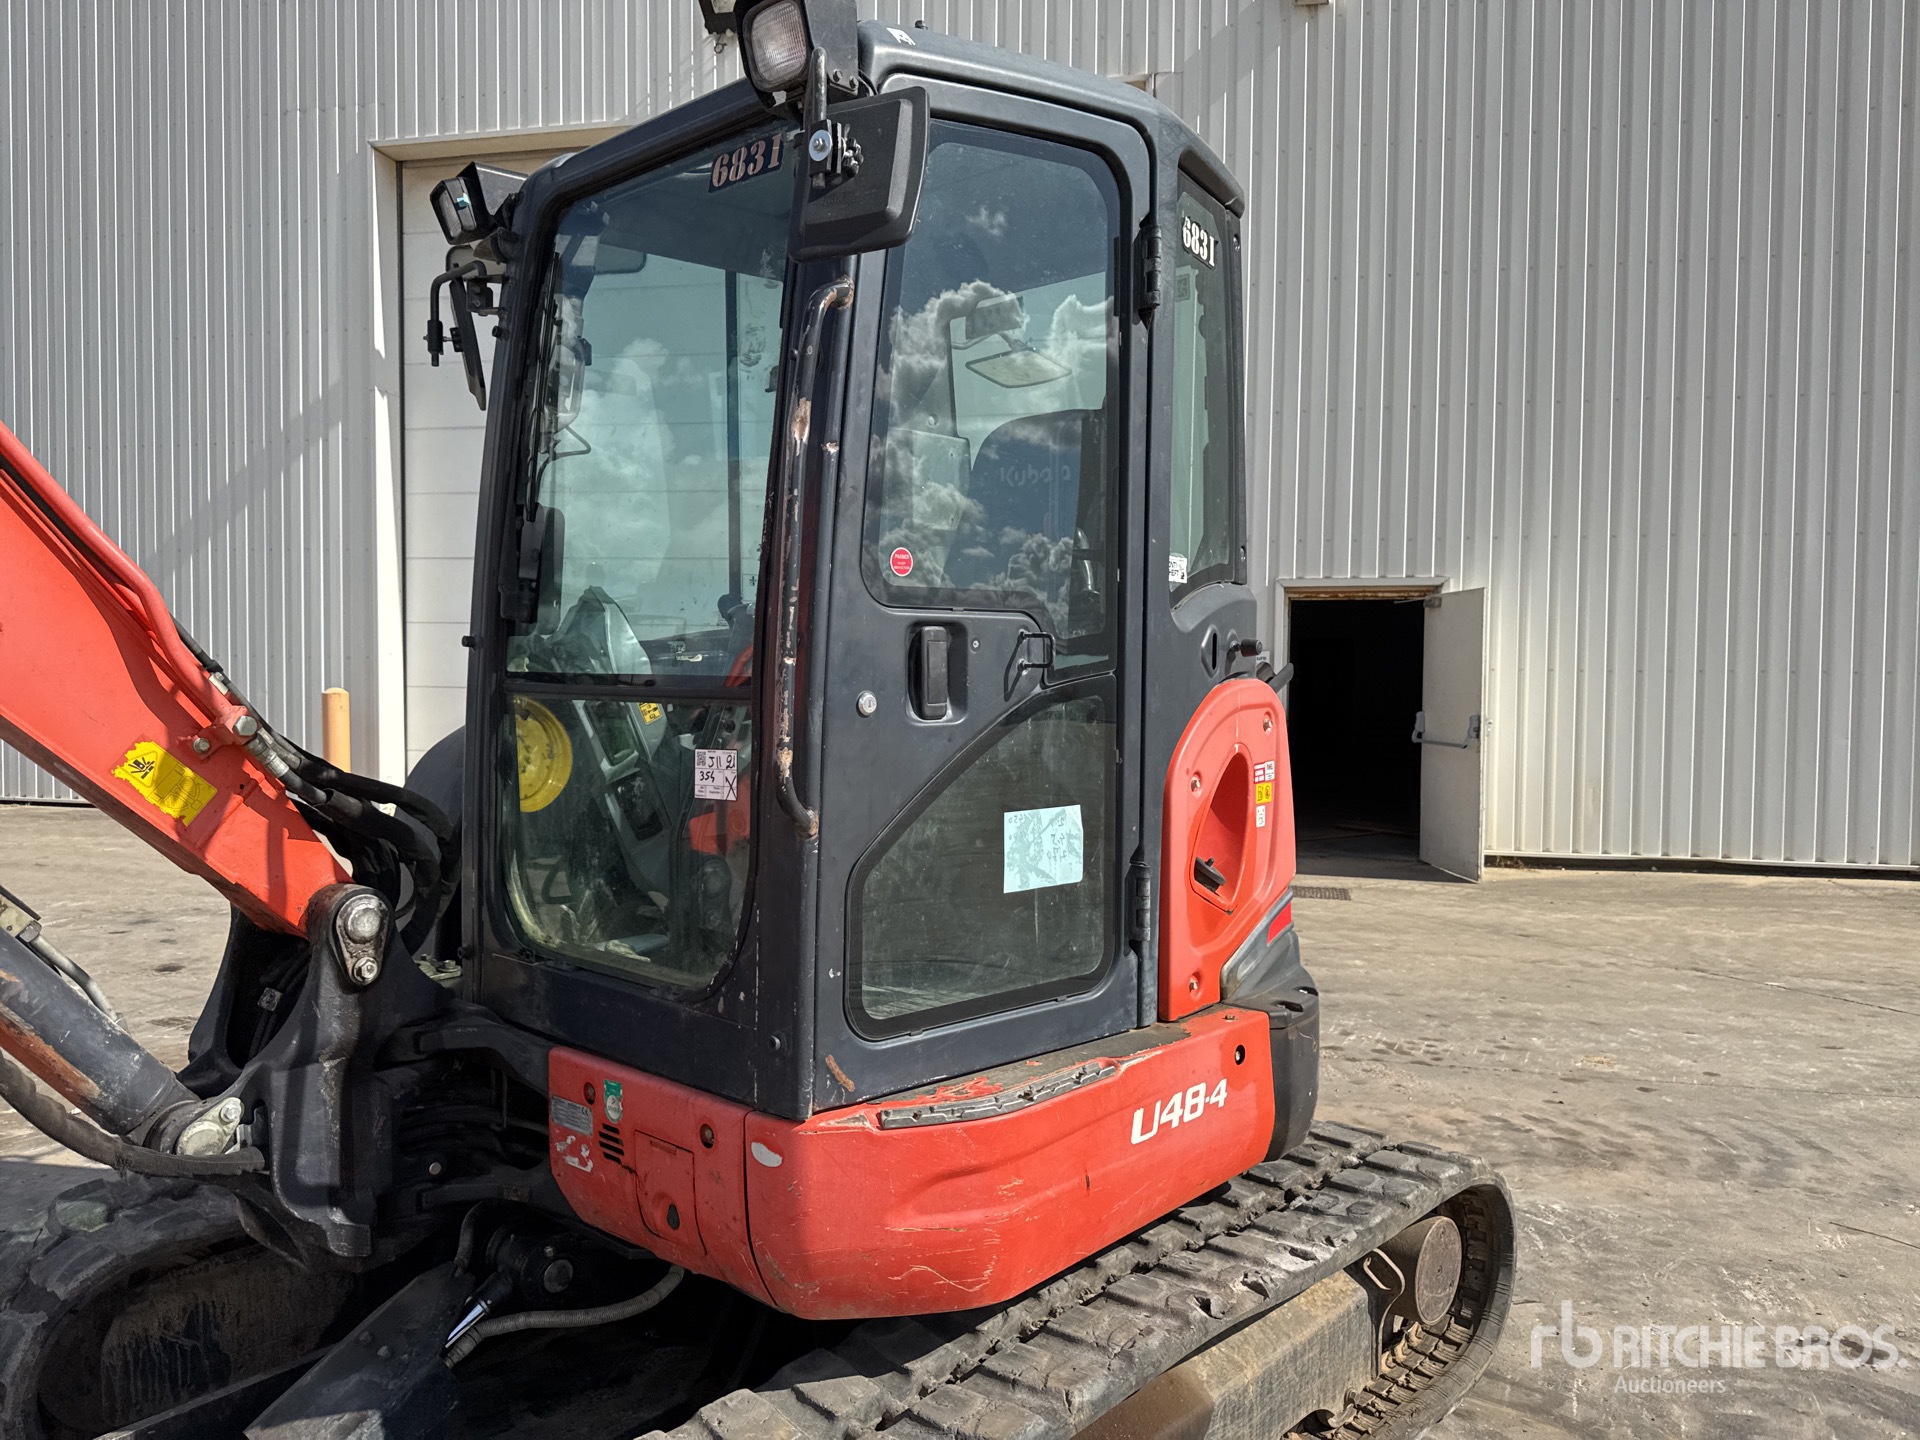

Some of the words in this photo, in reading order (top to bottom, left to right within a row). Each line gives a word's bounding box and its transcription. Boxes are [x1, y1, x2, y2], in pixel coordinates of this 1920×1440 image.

[712, 133, 782, 188] 6831
[1182, 216, 1215, 267] 6831
[1130, 1078, 1228, 1145] U48-4
